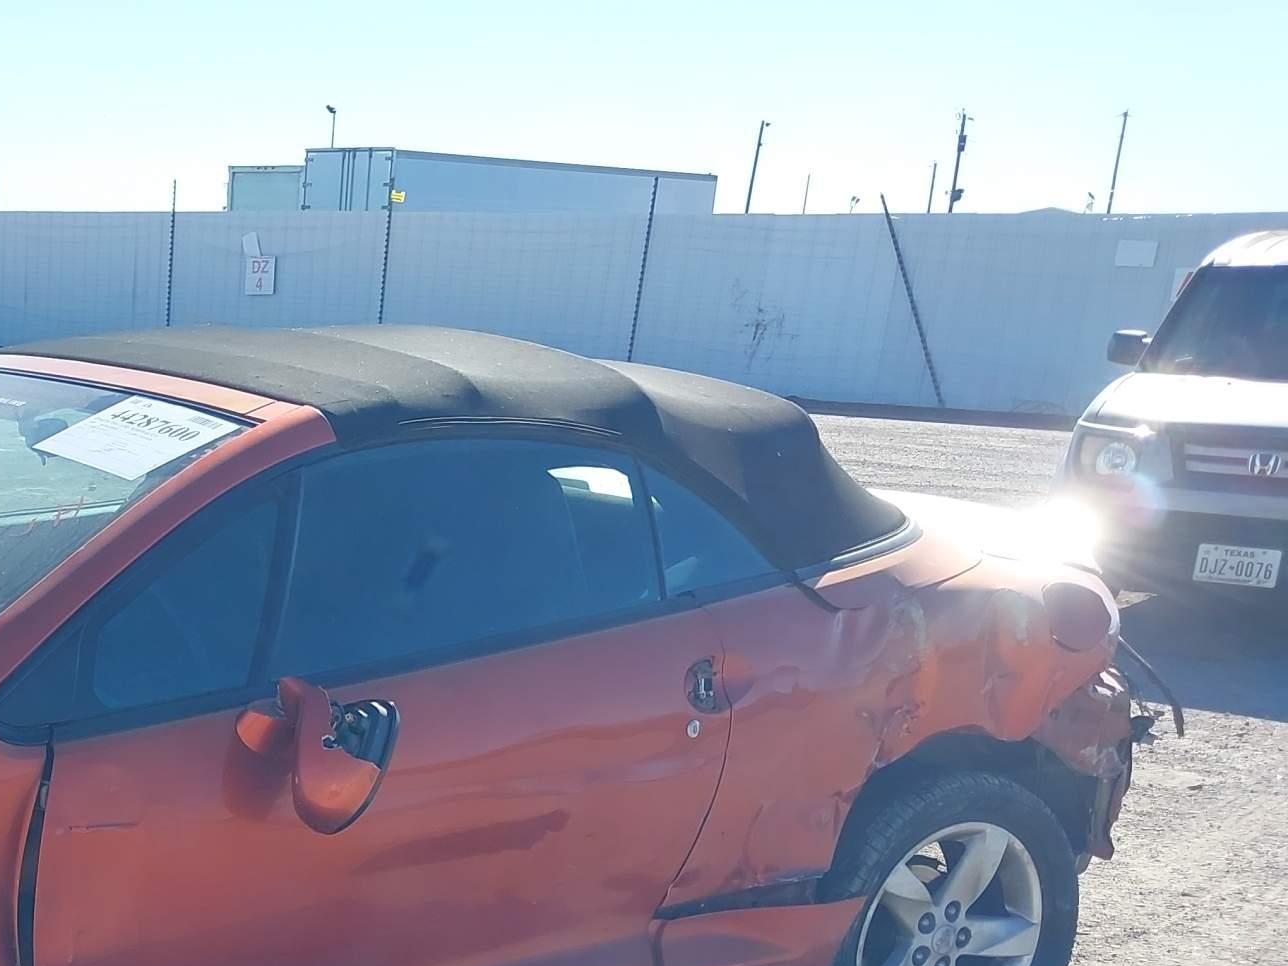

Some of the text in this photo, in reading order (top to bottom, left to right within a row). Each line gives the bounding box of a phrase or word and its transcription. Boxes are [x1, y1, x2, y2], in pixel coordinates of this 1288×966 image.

[252, 260, 269, 273] DZ
[255, 277, 263, 290] 4
[111, 409, 201, 442] 44287600
[1224, 549, 1255, 559] TEXAS
